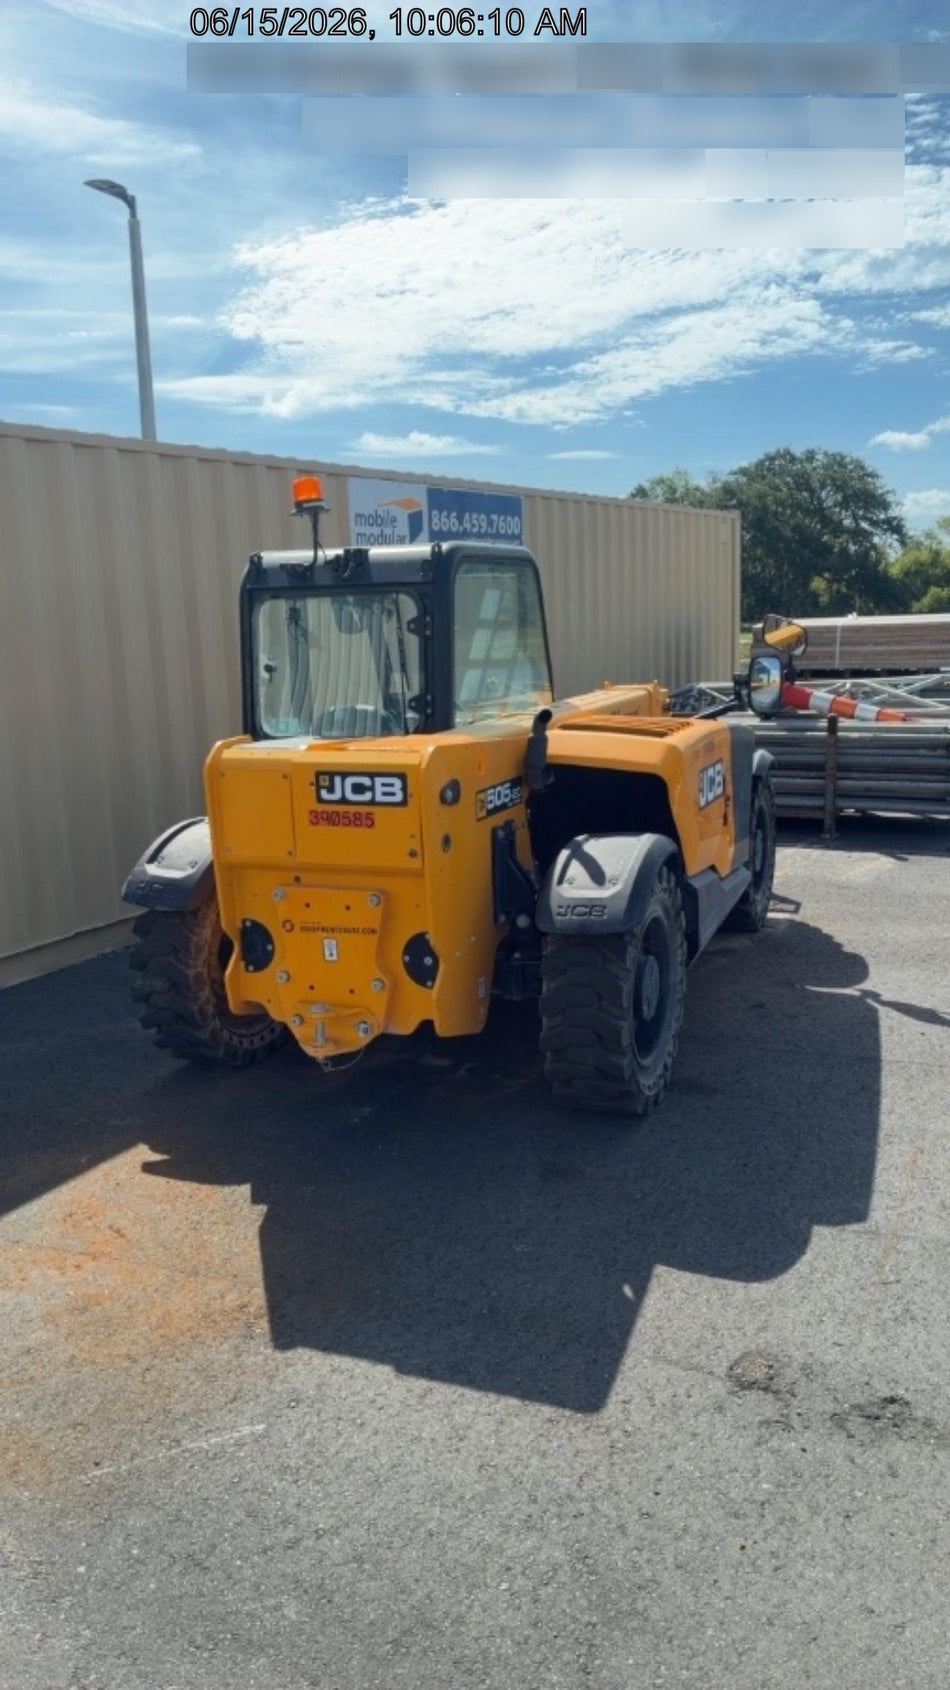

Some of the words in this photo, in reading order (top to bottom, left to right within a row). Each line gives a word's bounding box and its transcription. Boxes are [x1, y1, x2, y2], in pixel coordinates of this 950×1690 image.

[354, 510, 397, 528] mobile
[431, 510, 521, 535] 866.459.7600
[356, 530, 406, 545] modular
[320, 775, 405, 803] JCB
[700, 761, 724, 808] JCB
[309, 811, 375, 829] 390585
[556, 904, 608, 918] JCB
